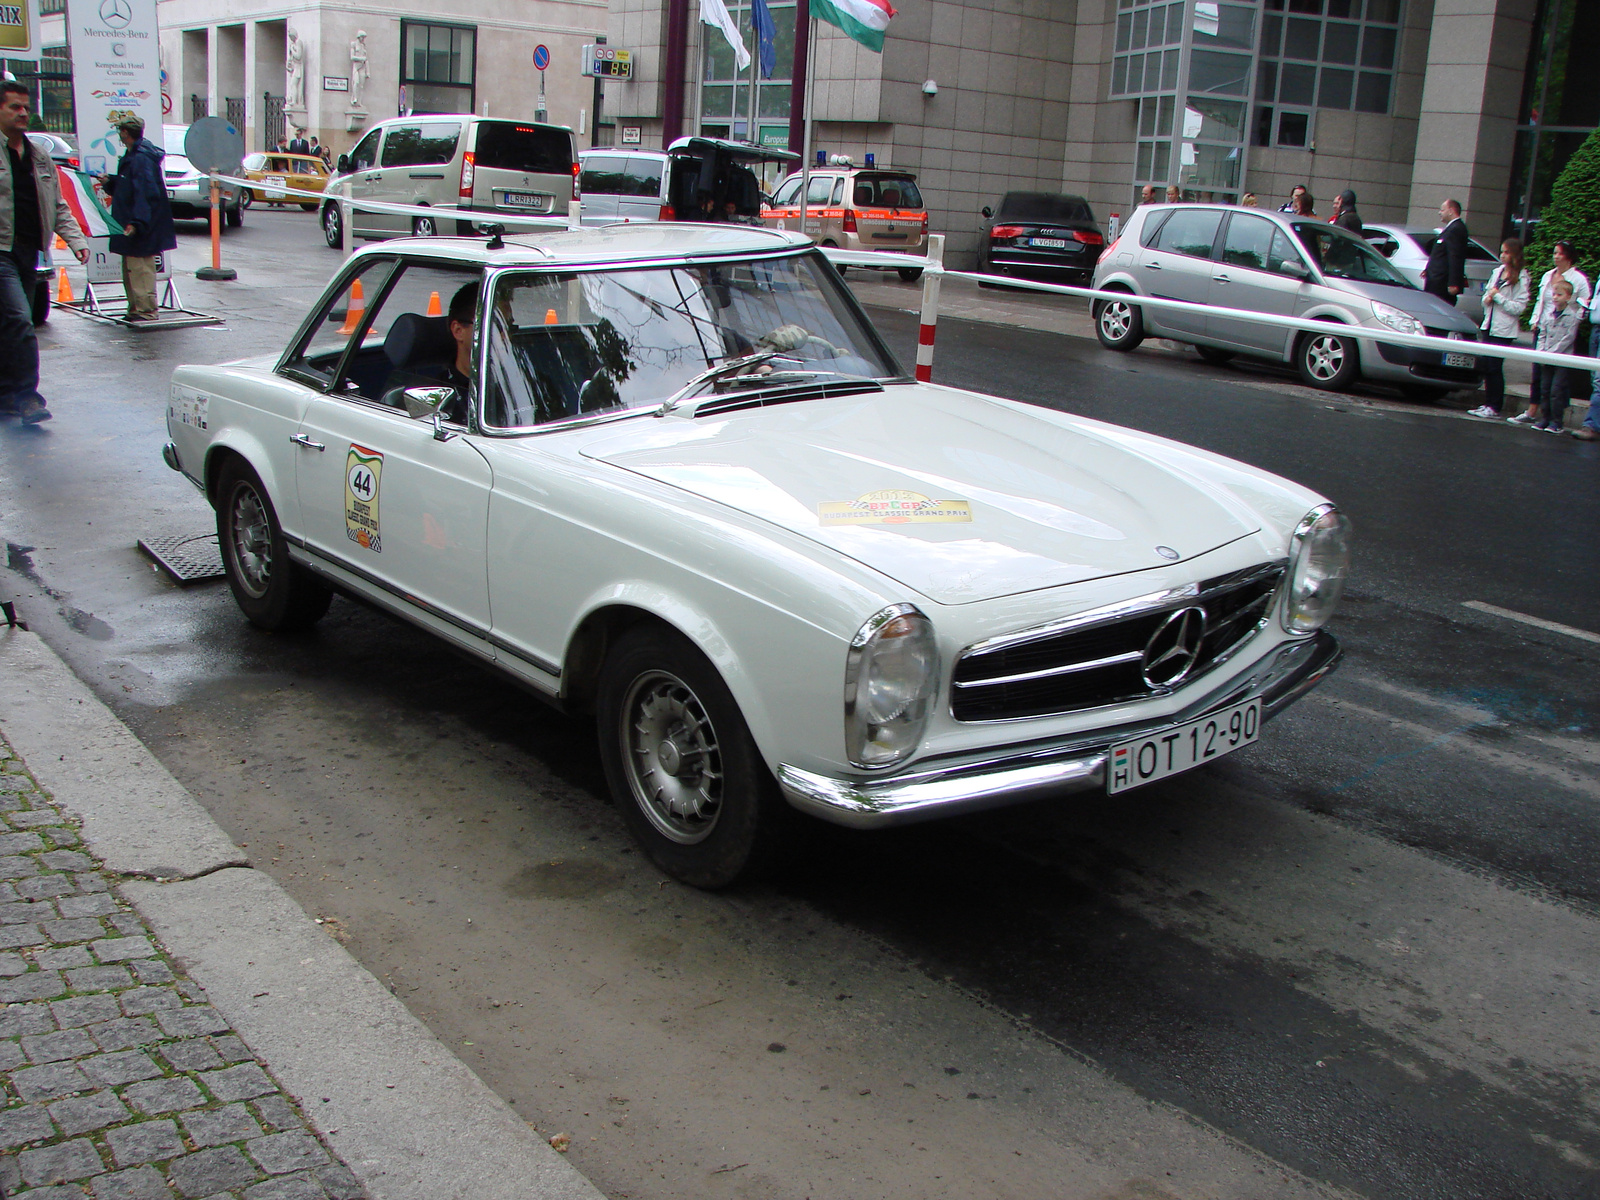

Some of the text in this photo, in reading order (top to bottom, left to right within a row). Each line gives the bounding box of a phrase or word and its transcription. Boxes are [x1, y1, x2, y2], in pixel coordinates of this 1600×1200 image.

[0, 4, 22, 25] RIX
[84, 27, 149, 39] Mercedes-Benz
[95, 61, 145, 70] Kempinski Hotel
[611, 62, 629, 77] 89
[106, 69, 135, 77] Corvinus
[764, 135, 789, 145] Europcar
[353, 470, 371, 496] 44
[869, 501, 921, 510] BPCGP
[823, 511, 870, 519] BUDAPEST
[1138, 704, 1257, 778] OT 12-90
[1115, 768, 1128, 788] H
